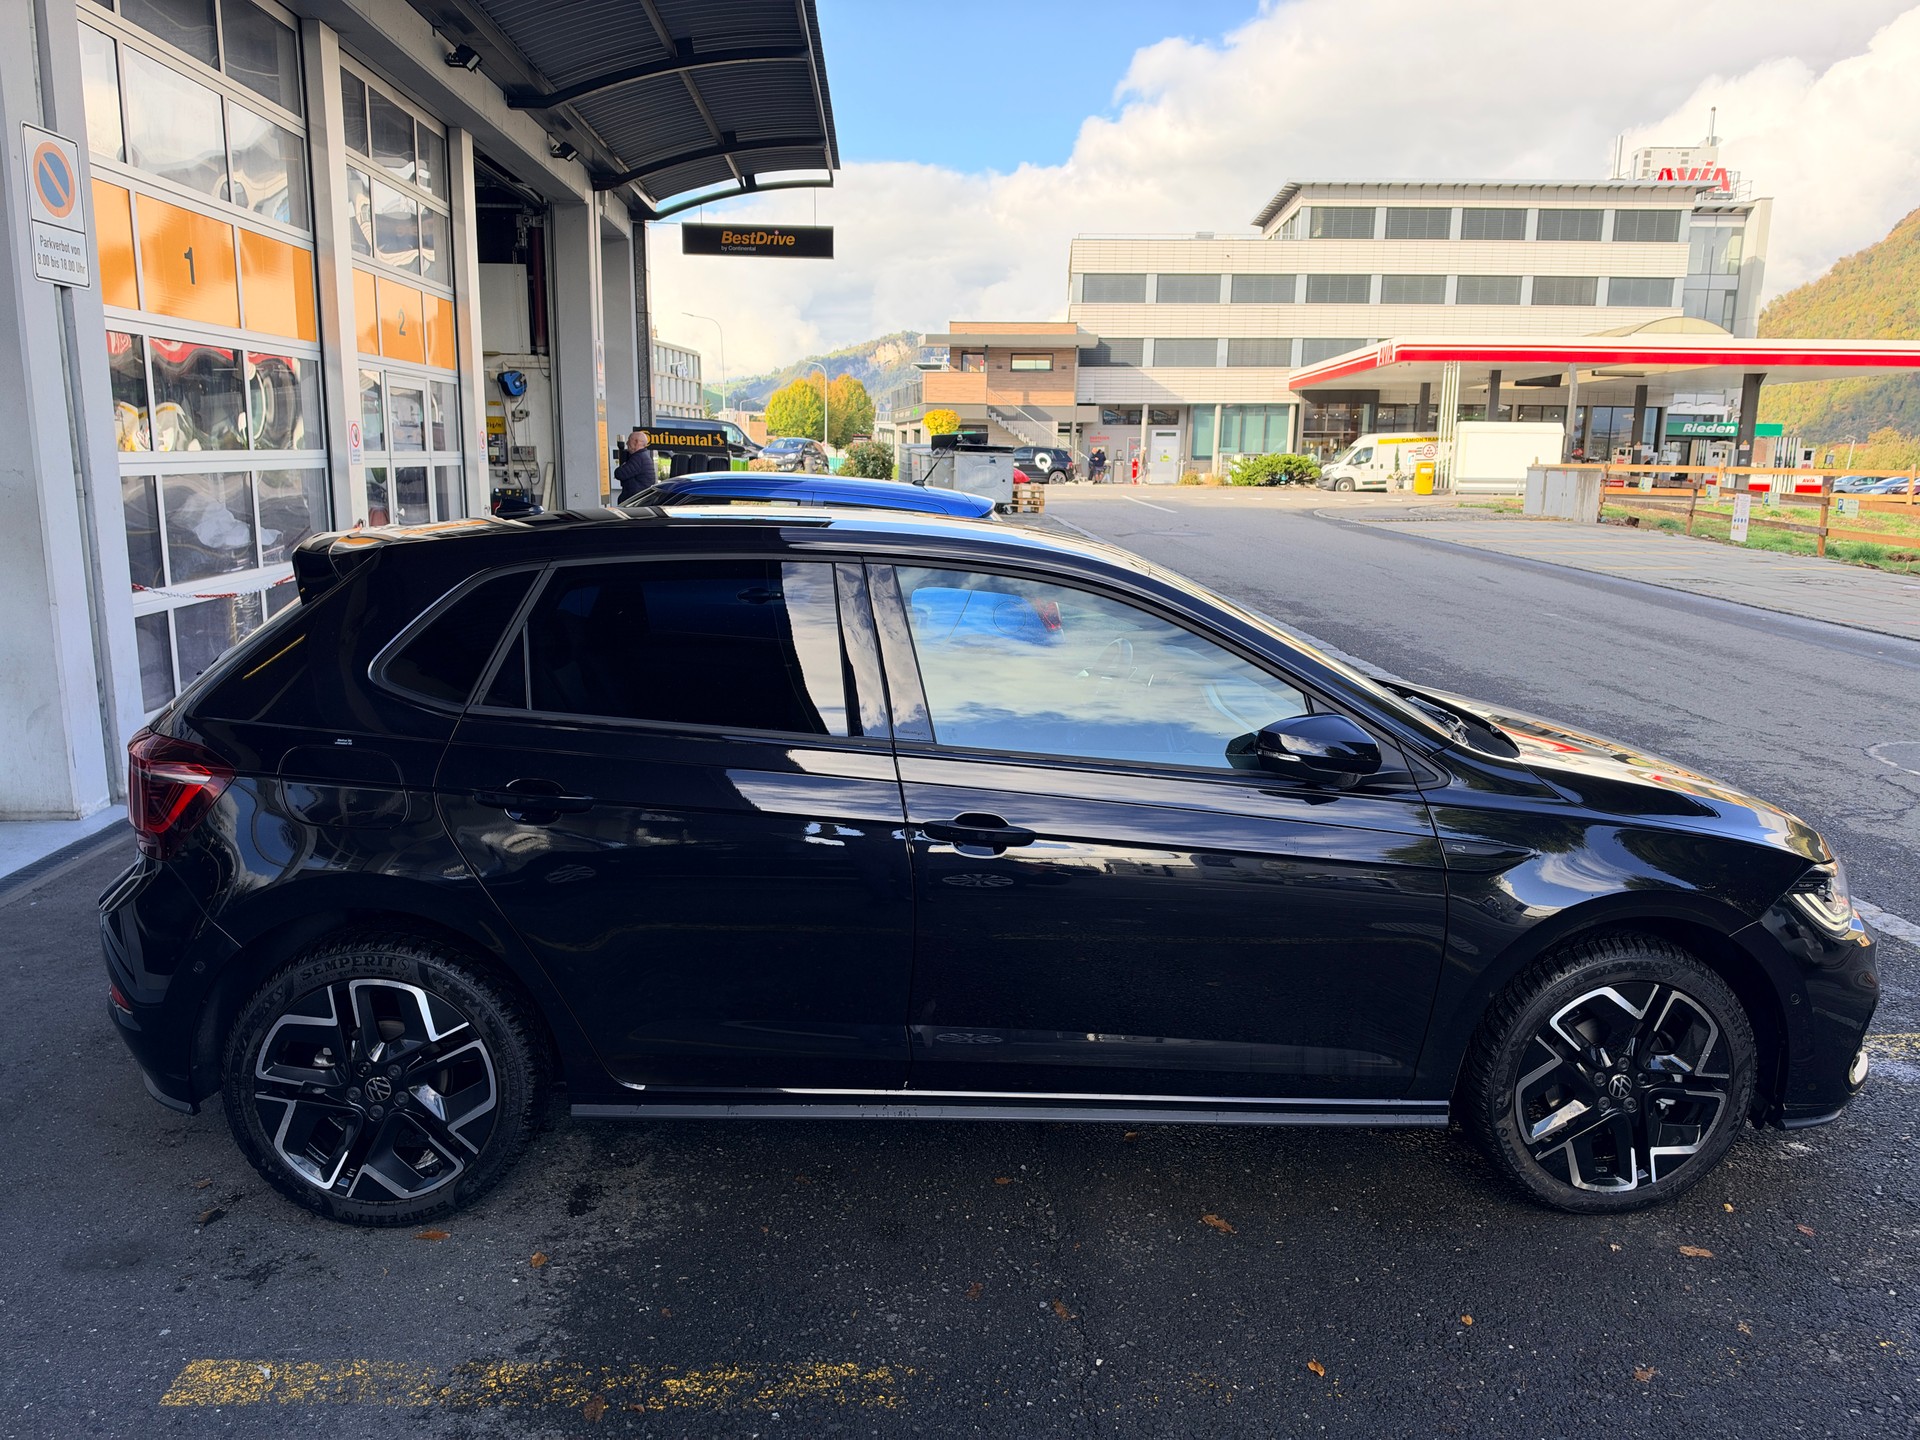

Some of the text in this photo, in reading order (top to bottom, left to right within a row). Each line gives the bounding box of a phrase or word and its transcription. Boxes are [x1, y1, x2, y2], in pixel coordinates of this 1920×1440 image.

[39, 234, 81, 256] Parkverbot von
[721, 230, 795, 246] BestDrive
[37, 253, 50, 267] 8.00
[51, 256, 60, 269] bis
[76, 261, 86, 275] Uhr
[183, 246, 196, 285] 1
[398, 308, 406, 336] 2
[1682, 423, 1736, 434] Rieden
[301, 955, 397, 981] SEMPERIT
